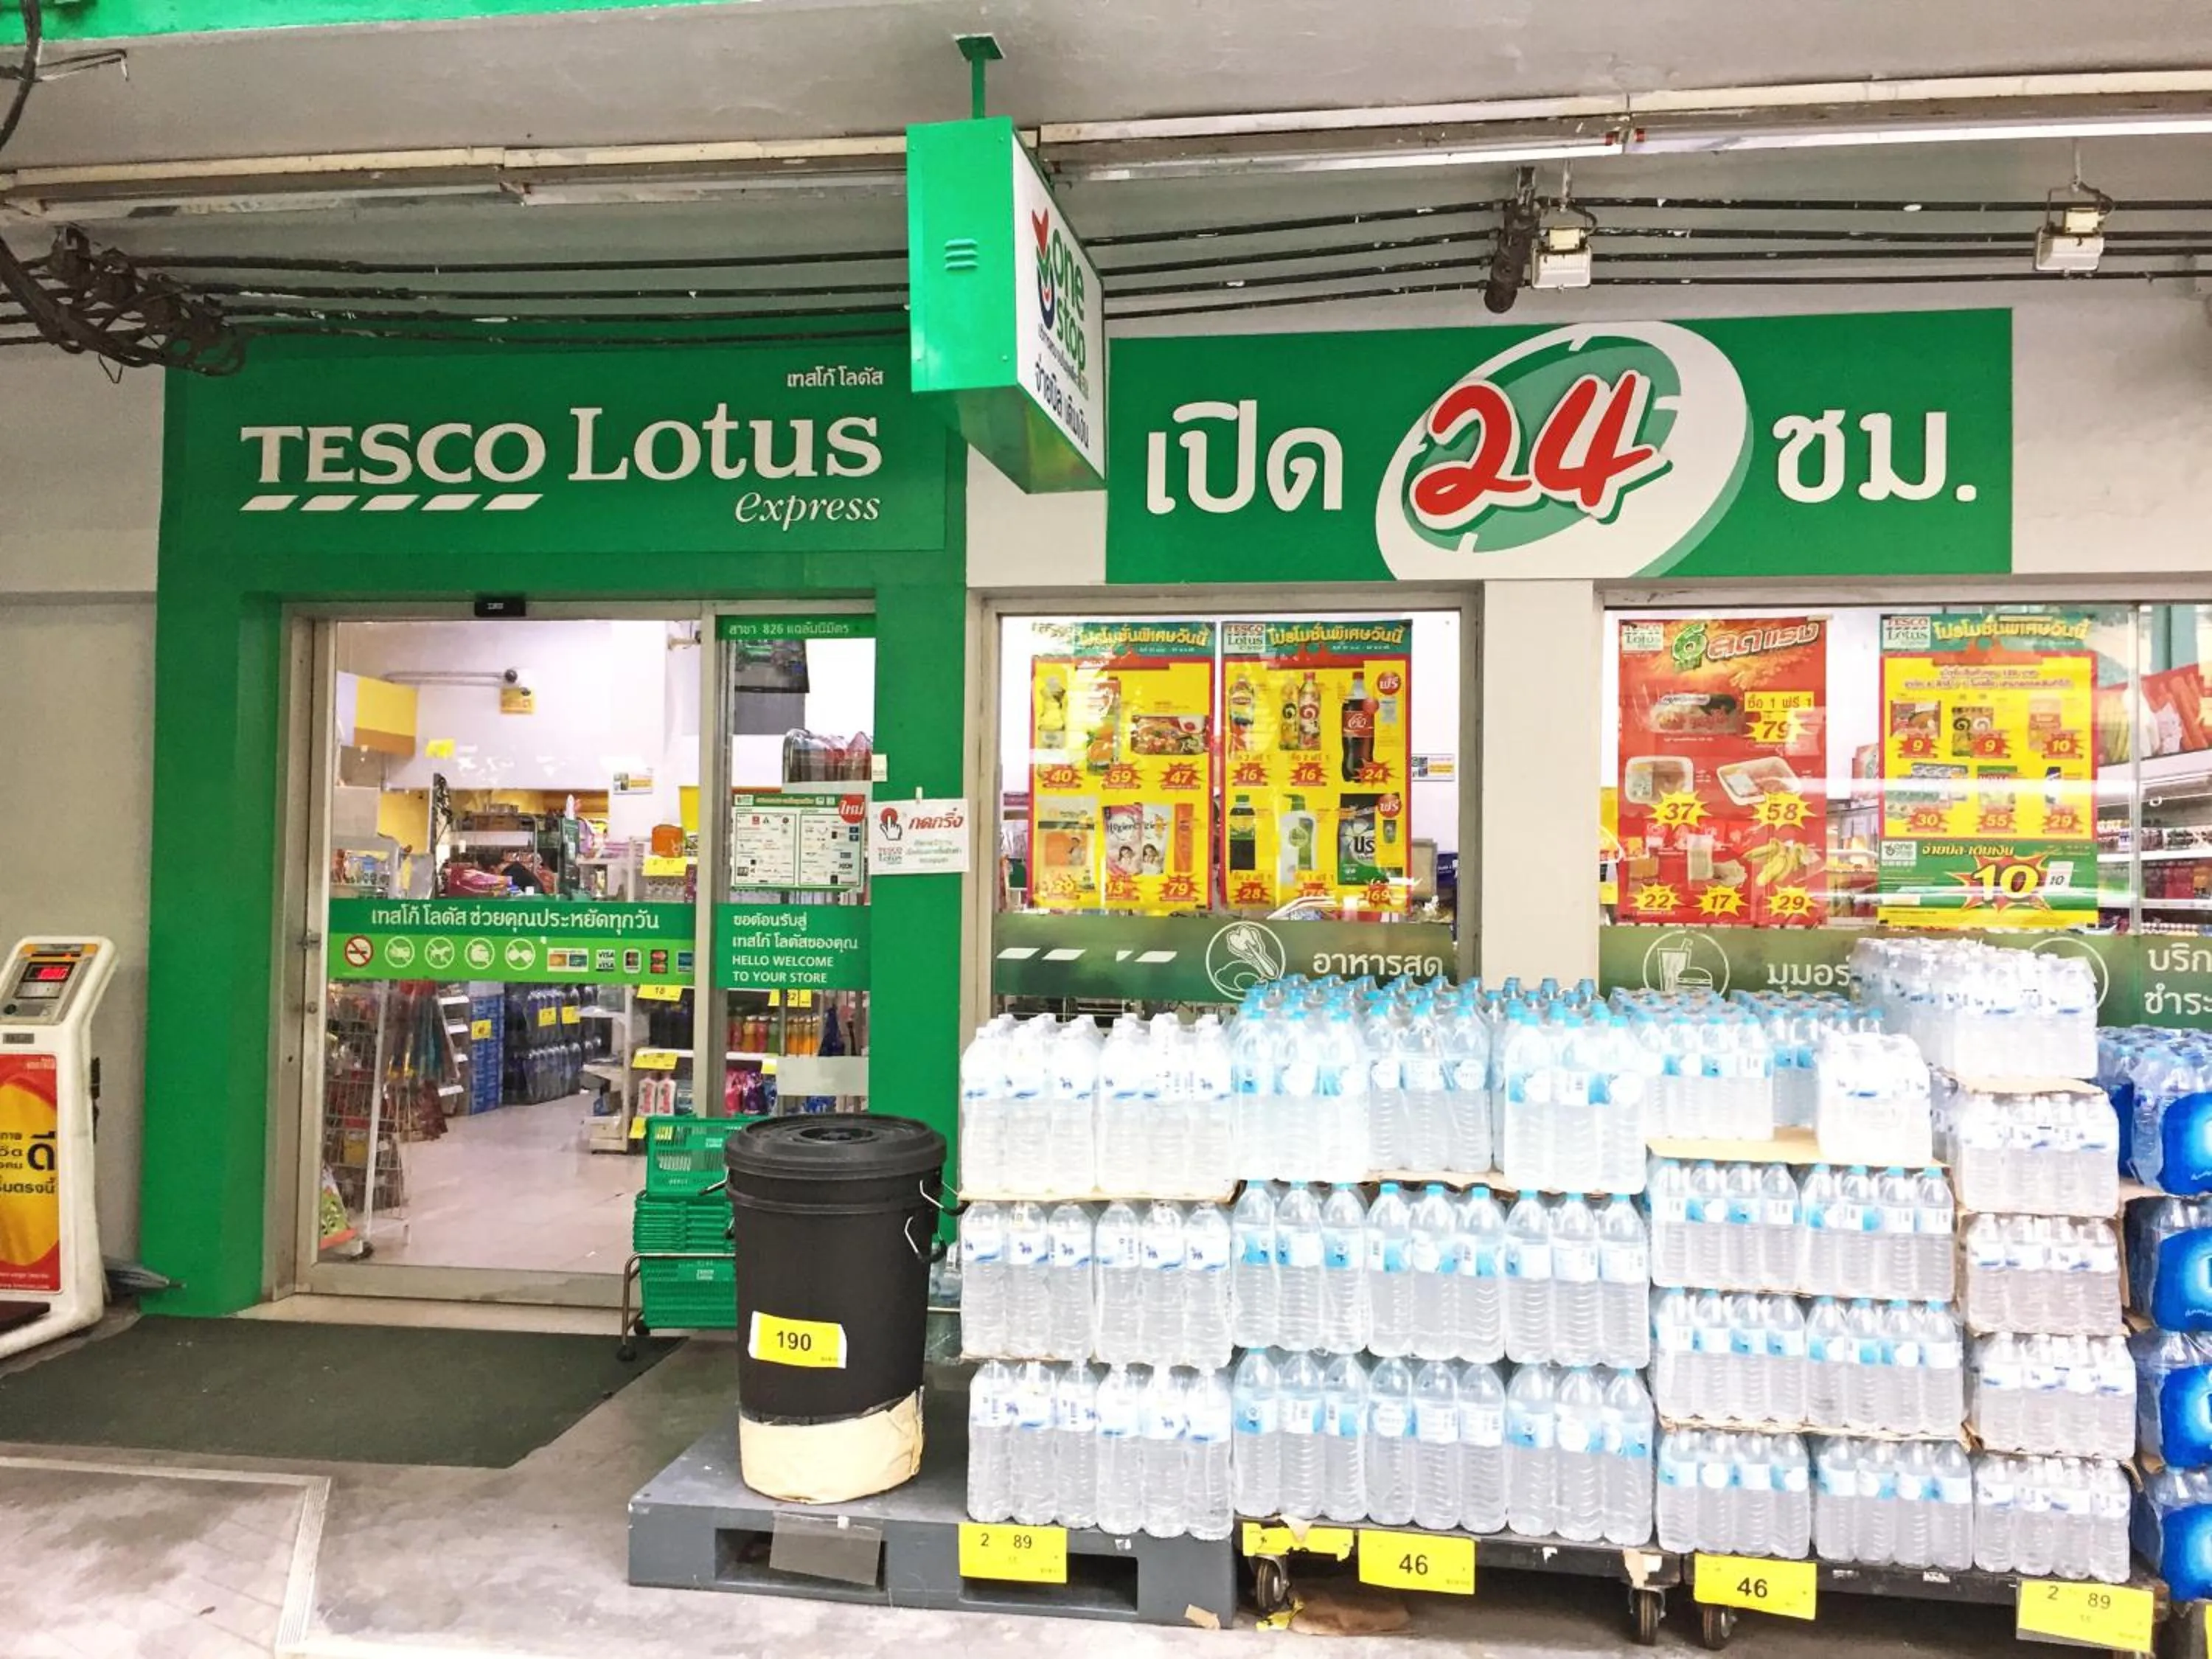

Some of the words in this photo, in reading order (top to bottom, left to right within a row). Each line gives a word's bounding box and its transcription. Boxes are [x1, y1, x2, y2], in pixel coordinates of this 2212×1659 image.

[1052, 229, 1085, 321] one
[1057, 296, 1087, 376] stop
[787, 366, 835, 387] เทสโก้
[240, 422, 546, 484] TESCO
[568, 403, 883, 482] Lotus
[1147, 400, 1342, 515] เปิด
[1409, 370, 1660, 524] 24
[1773, 411, 1978, 505] ชม.
[734, 491, 880, 531] express
[762, 623, 784, 635] 826
[1770, 698, 1775, 708] 1
[1806, 698, 1812, 707] 1
[1912, 740, 1924, 752] 9
[1984, 740, 1996, 752] 9
[2052, 740, 2070, 752] 10
[1051, 771, 1073, 782] 40
[1110, 770, 1132, 783] 59
[1169, 771, 1191, 784] 47
[1242, 769, 1258, 781] 16
[1300, 769, 1316, 781] 16
[1364, 768, 1384, 780] 24
[908, 807, 964, 830] กดกริ่ง
[1664, 802, 1695, 821] 37
[1767, 802, 1799, 821] 58
[1917, 813, 1938, 825] 30
[1985, 815, 2008, 827] 55
[1168, 882, 1189, 896] 79
[1972, 863, 2039, 901] 10
[1242, 888, 1262, 900] 28
[1644, 894, 1671, 908] 22
[1710, 894, 1731, 908] 17
[1778, 895, 1806, 910] 29
[372, 903, 419, 925] เทสโก้
[422, 904, 467, 925] โลตัส
[470, 905, 659, 936] ช่วยคุณประหยัดทุกวัน
[733, 911, 807, 931] ขอต้อนรับสู่
[732, 931, 772, 948] เทสโก้
[732, 955, 769, 966] HELLO
[772, 956, 834, 967] WELCOME
[1312, 953, 1443, 978] อาหารสด
[2147, 942, 2212, 973] บริก
[732, 971, 749, 981] TO
[753, 971, 787, 983] YOUR
[790, 972, 828, 984] STORE
[28, 1130, 56, 1172] ดี
[775, 1329, 813, 1353] 190
[980, 1532, 991, 1548] 2
[1012, 1534, 1033, 1551] 89
[1398, 1553, 1429, 1578] 46
[1736, 1576, 1769, 1600] 46
[2046, 1584, 2060, 1601] 2
[2087, 1591, 2112, 1612] 89
